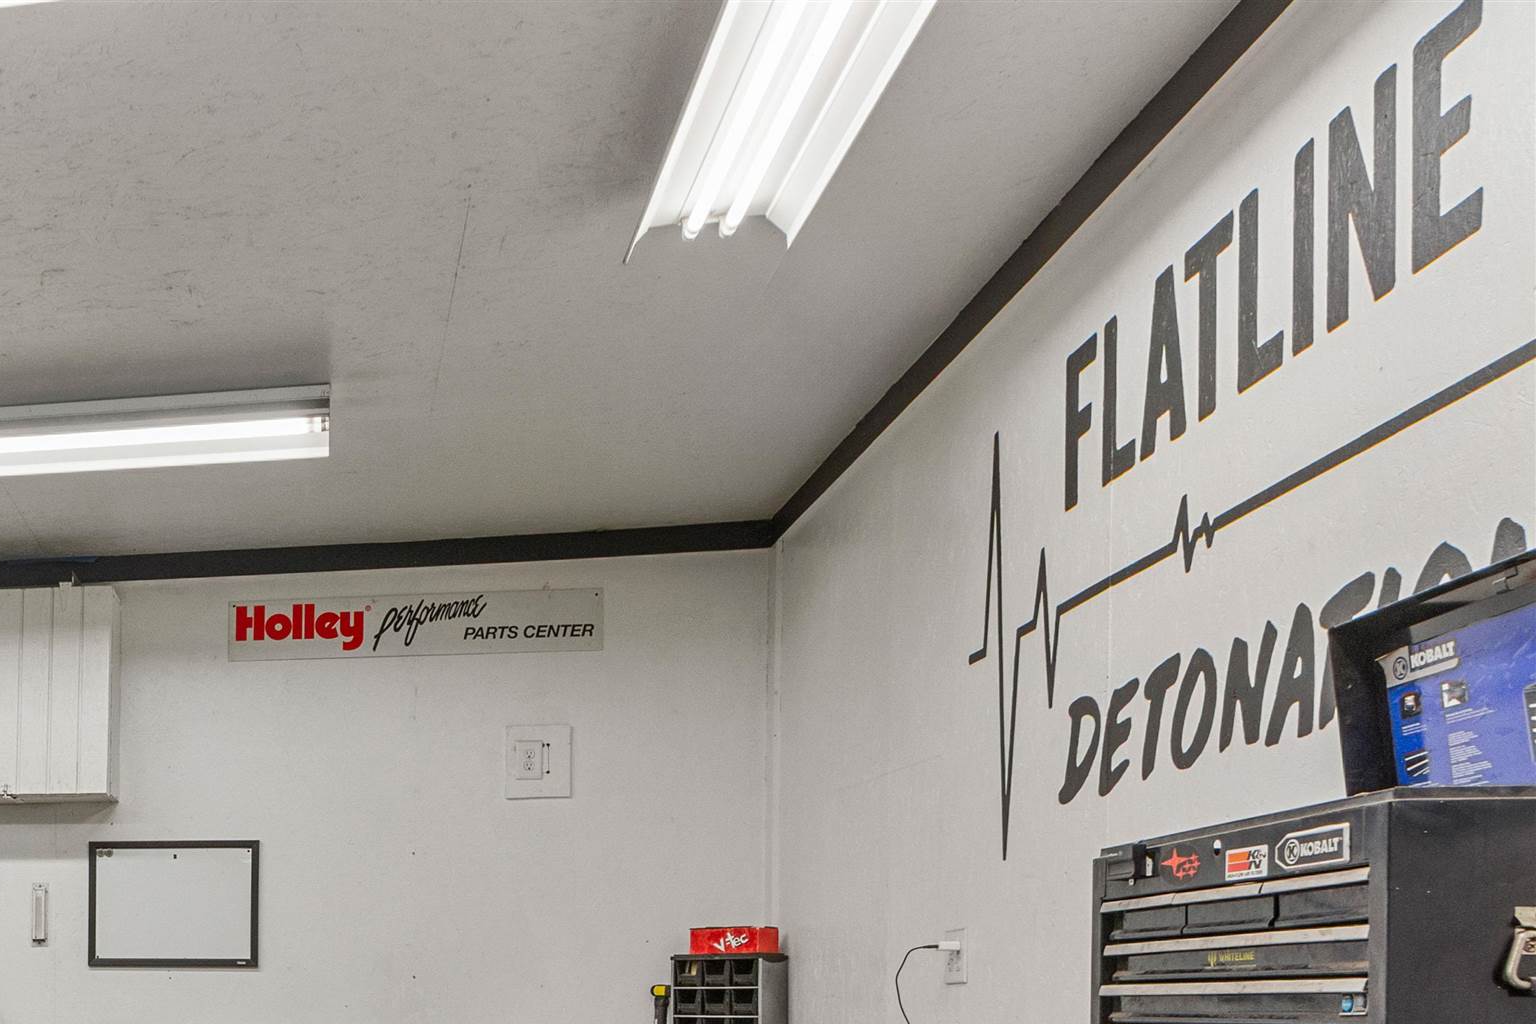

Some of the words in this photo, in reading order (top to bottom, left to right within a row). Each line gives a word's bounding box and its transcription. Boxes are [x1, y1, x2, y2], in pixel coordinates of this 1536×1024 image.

[1064, 1, 1484, 512] FLATLINE
[235, 603, 364, 650] Holley
[373, 594, 487, 651] performance
[464, 626, 519, 640] PARTS
[523, 624, 595, 639] CENTER
[1058, 517, 1528, 804] DETONAT
[1410, 641, 1455, 669] KOBALT
[1300, 838, 1341, 858] KOBALT
